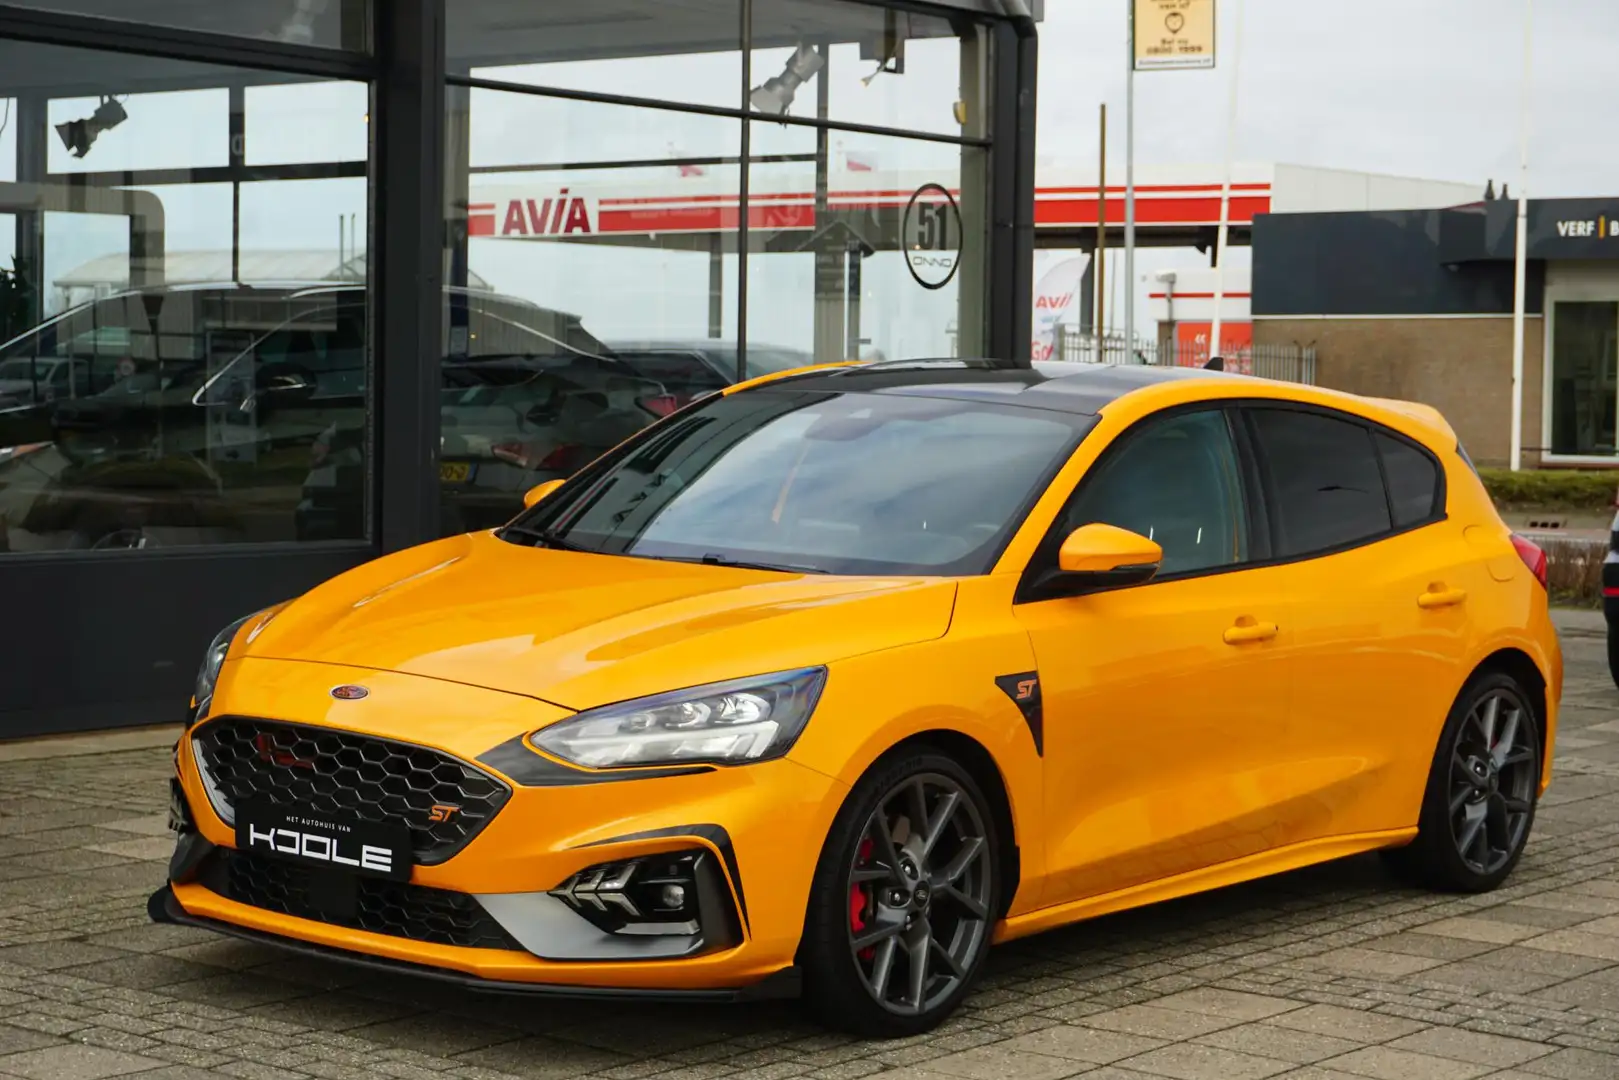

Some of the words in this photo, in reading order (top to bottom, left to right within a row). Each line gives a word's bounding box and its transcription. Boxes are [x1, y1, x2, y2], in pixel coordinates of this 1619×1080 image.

[502, 187, 591, 235] AVIA
[918, 202, 946, 250] 51
[1556, 220, 1595, 237] VERF
[1016, 680, 1037, 699] ST
[286, 815, 299, 823] HET
[301, 818, 335, 830] AUTOHUIS
[429, 805, 459, 822] ST
[250, 824, 392, 873] KOOLE
